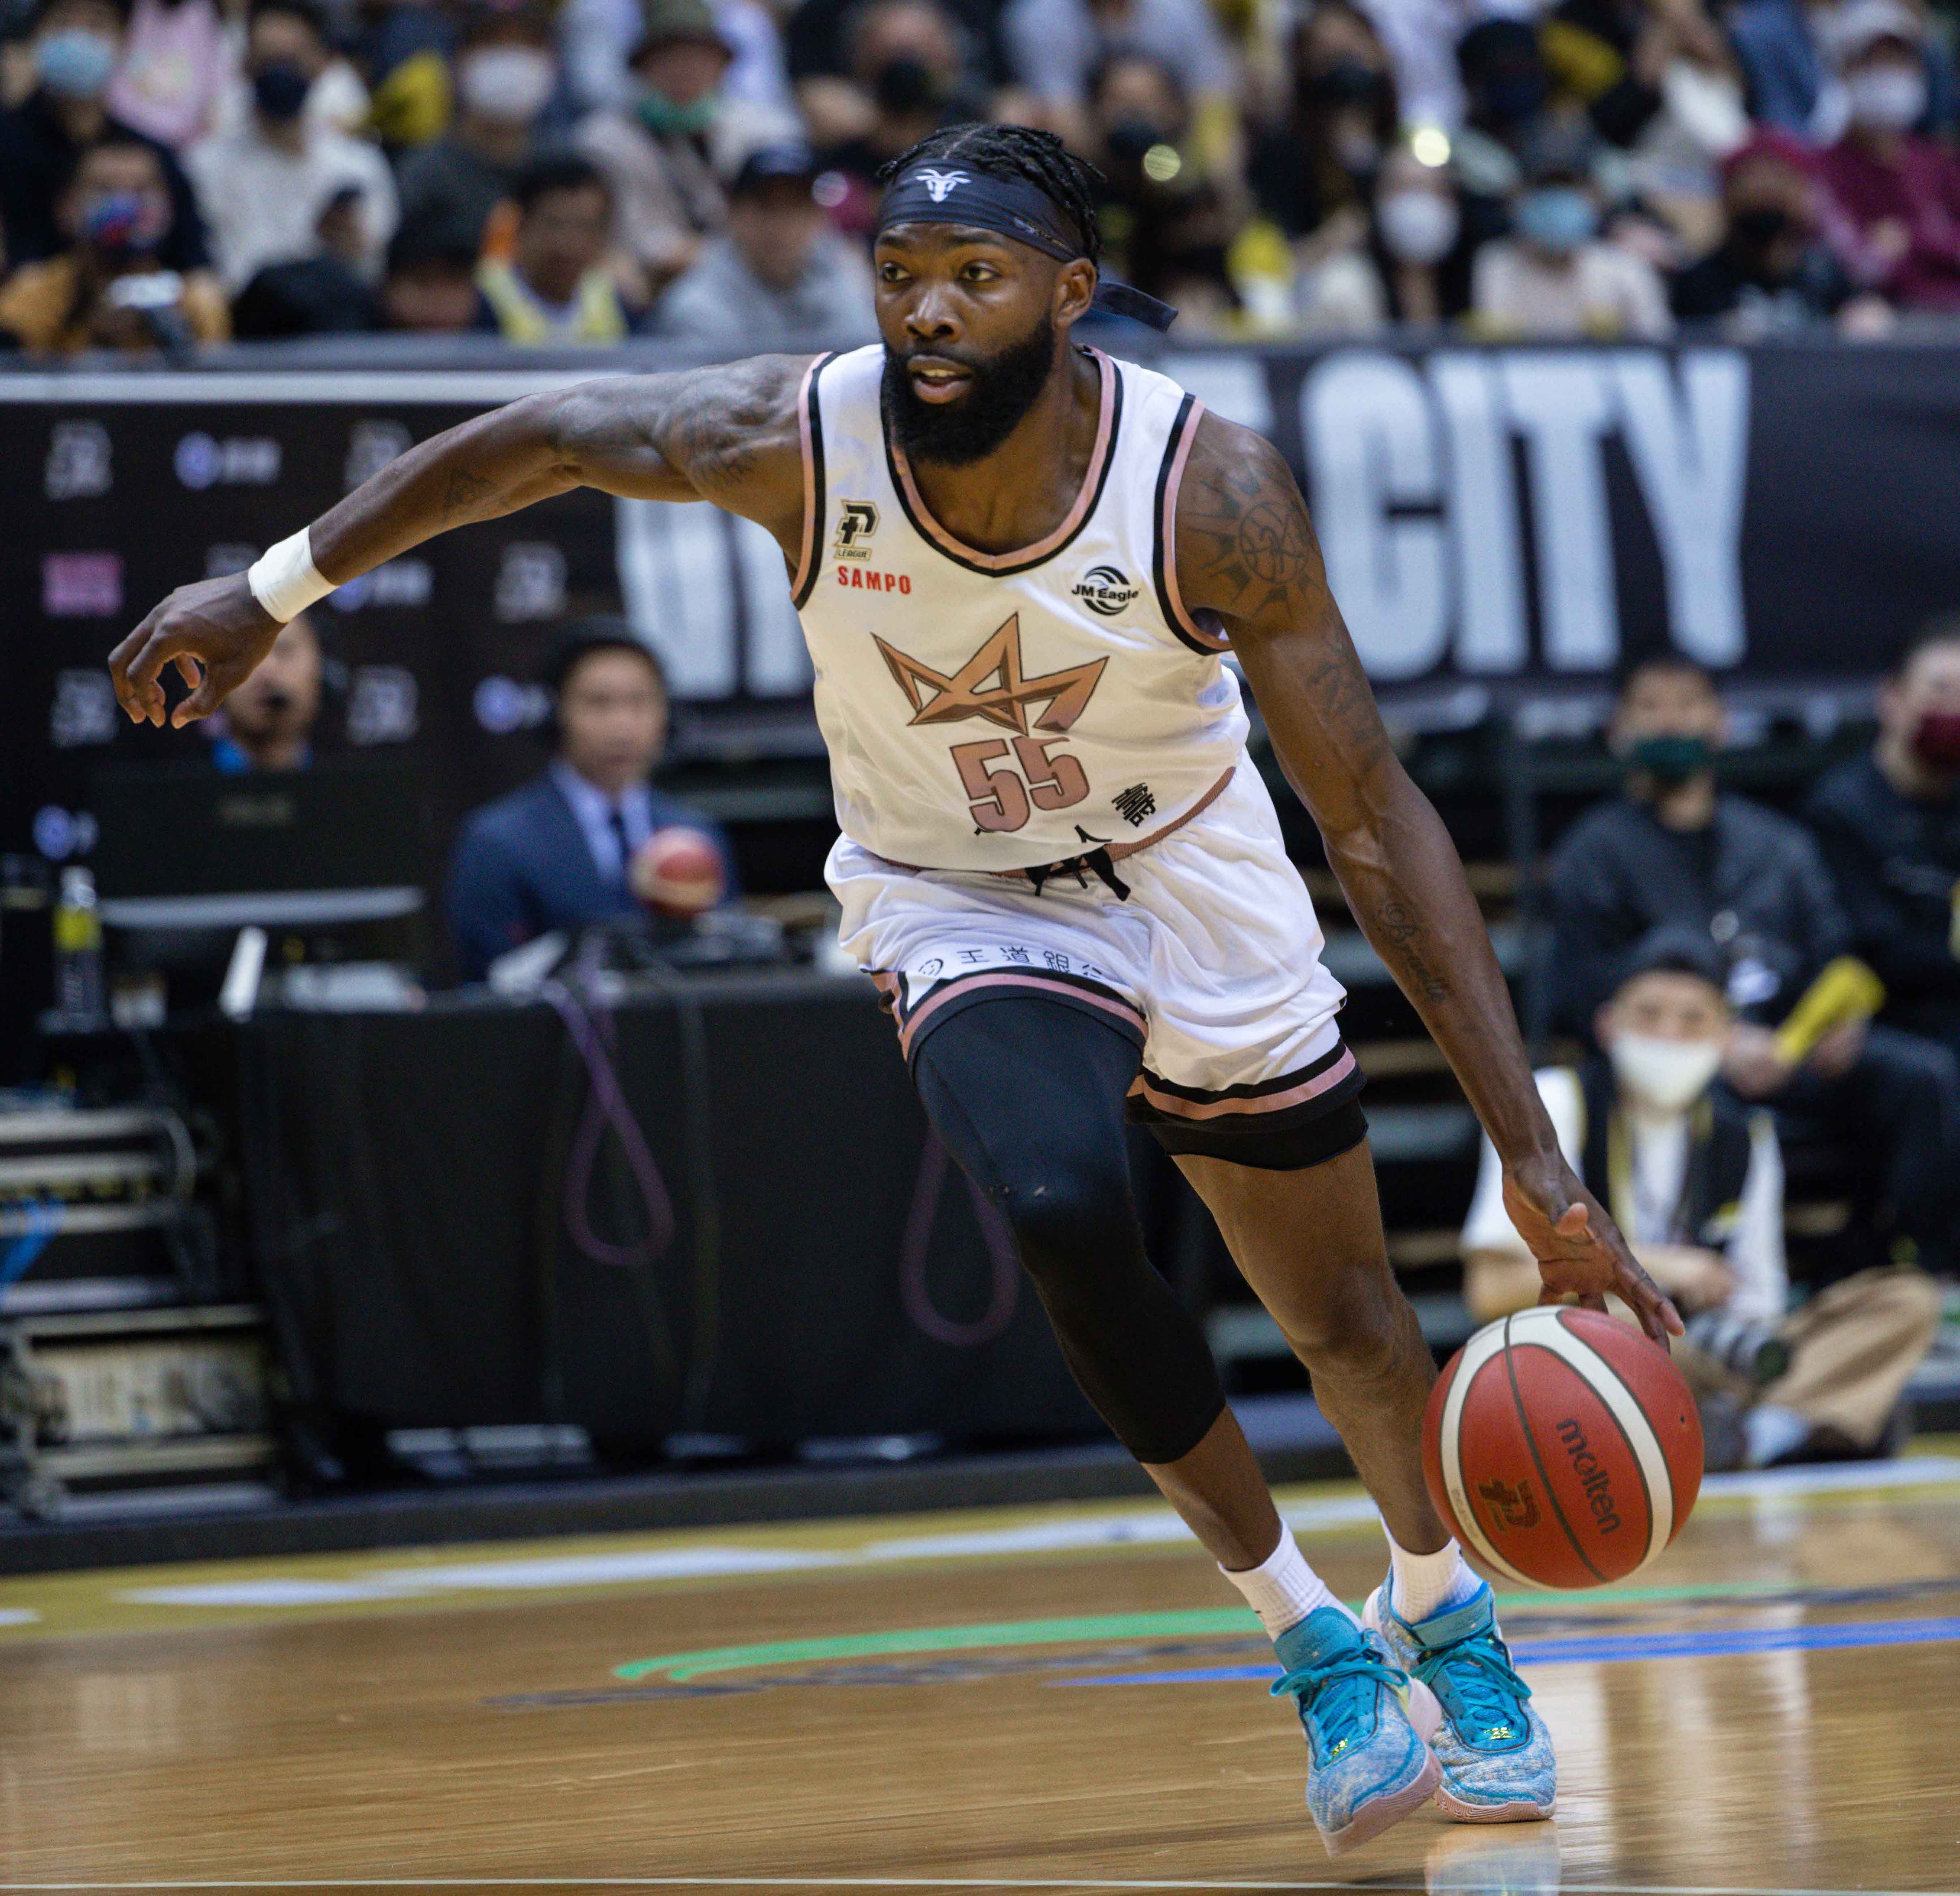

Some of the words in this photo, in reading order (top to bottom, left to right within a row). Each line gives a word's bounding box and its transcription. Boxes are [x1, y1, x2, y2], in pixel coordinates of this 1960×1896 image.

[1301, 349, 1751, 679] CITY
[837, 565, 911, 595] SAMPO
[1071, 584, 1094, 597] JM
[1097, 589, 1139, 602] Eagle
[949, 735, 1090, 833] 55
[1557, 1418, 1621, 1535] molten
